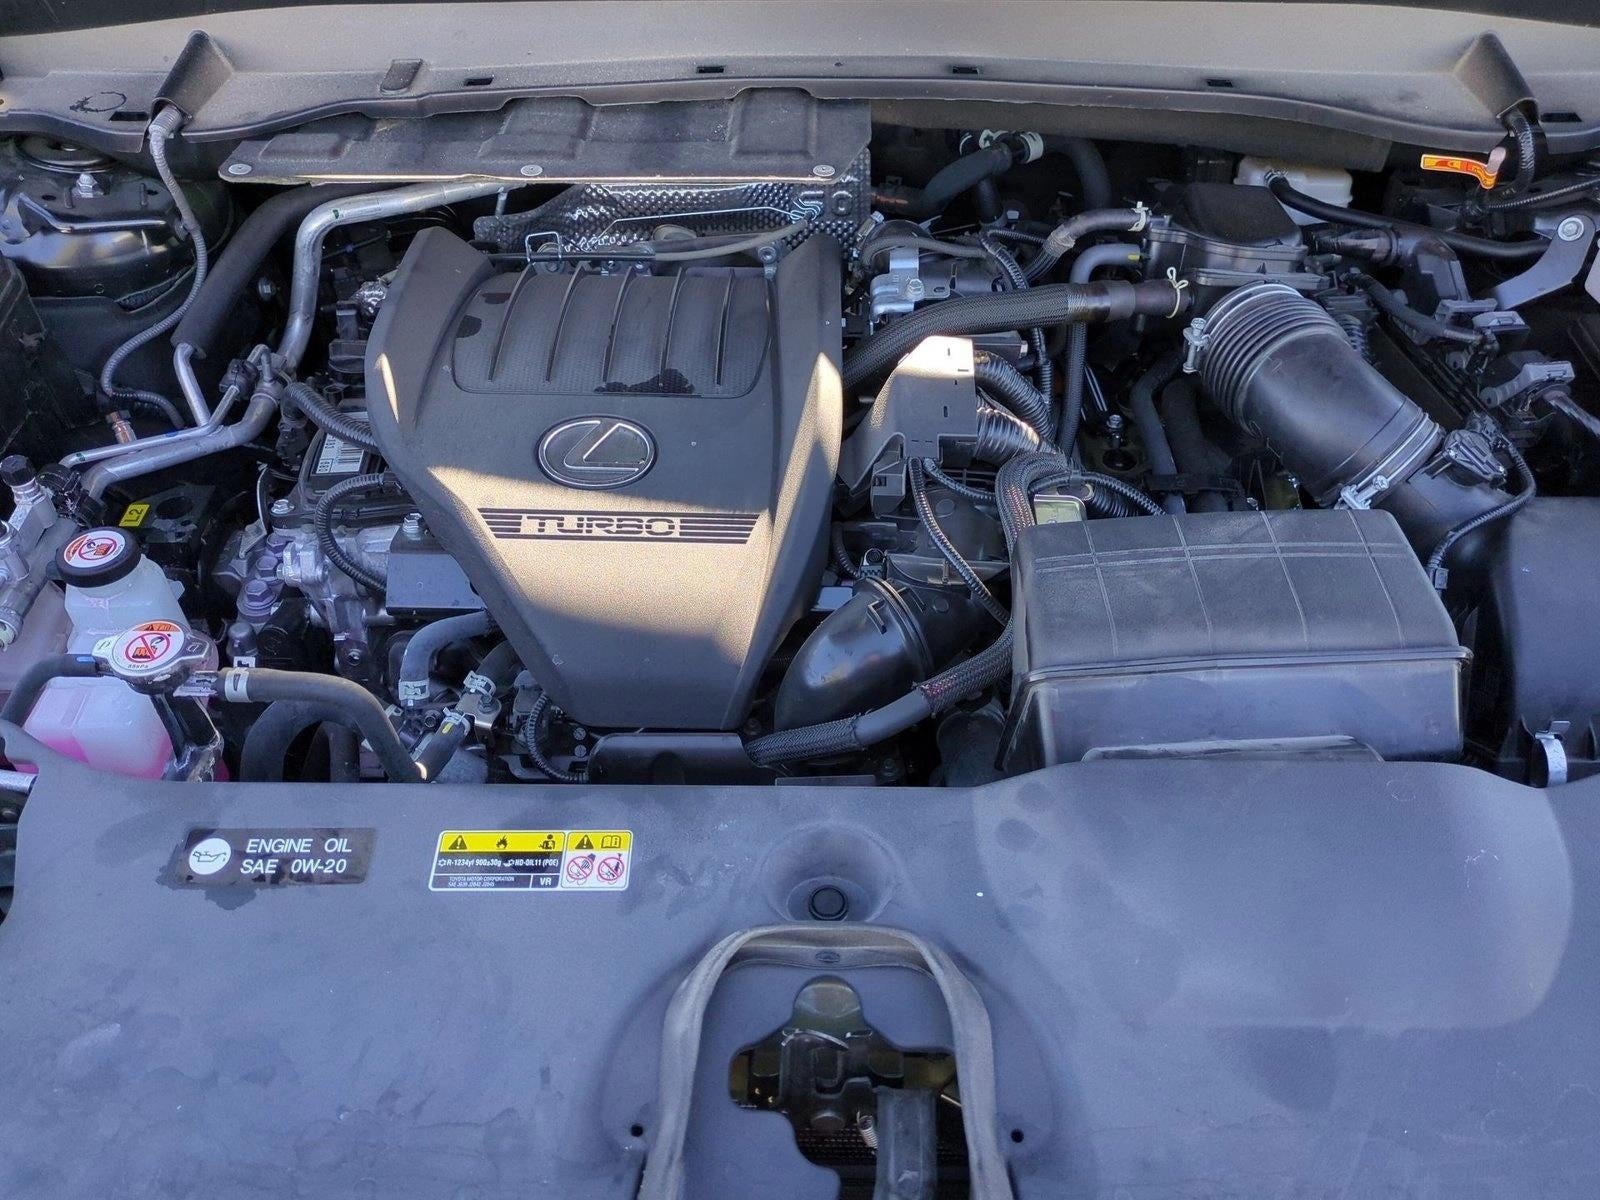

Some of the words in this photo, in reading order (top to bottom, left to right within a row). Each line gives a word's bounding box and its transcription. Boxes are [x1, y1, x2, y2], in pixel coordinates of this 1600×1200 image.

[526, 515, 676, 537] TURBO
[246, 838, 313, 853] ENGINE
[324, 838, 352, 853] OIL
[240, 858, 279, 874] SAE
[291, 858, 347, 874] 0W-20
[539, 877, 552, 886] VR
